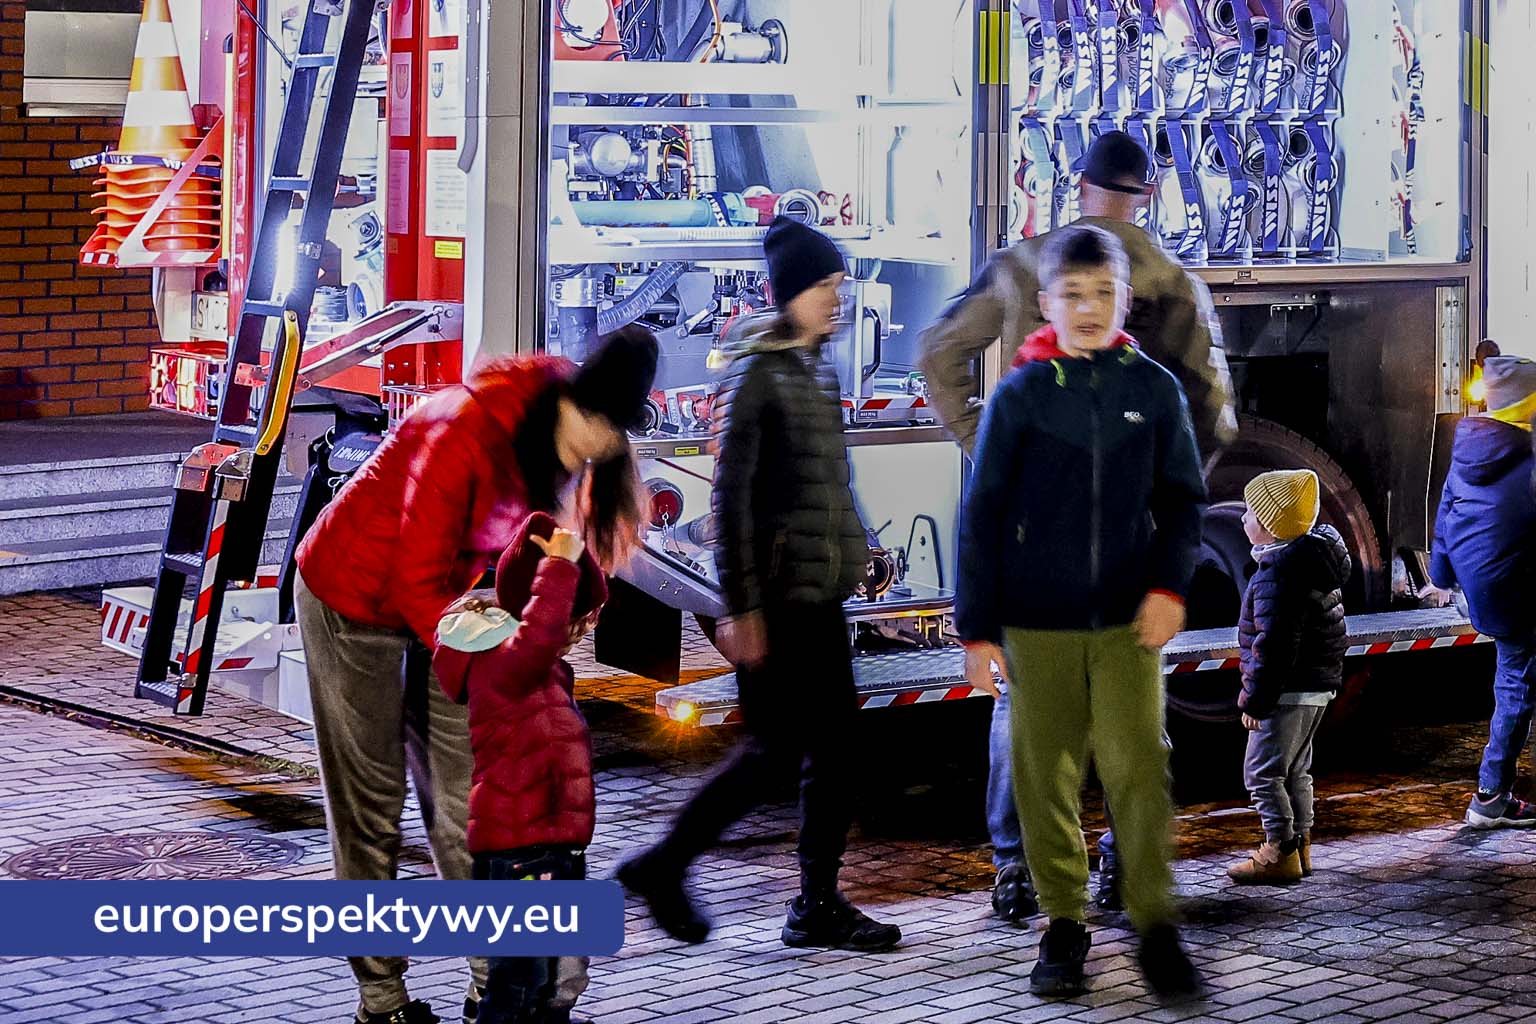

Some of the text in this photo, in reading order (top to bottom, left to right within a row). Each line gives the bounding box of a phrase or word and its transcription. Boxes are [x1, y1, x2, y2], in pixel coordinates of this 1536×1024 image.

[1074, 31, 1092, 96] WISS
[1101, 26, 1117, 95] WISS
[1139, 32, 1153, 97] WISS
[1188, 46, 1212, 108] WISS
[1228, 52, 1252, 112] WISS
[1263, 44, 1284, 111] WISS
[1311, 49, 1331, 111] WISS
[110, 155, 133, 165] WISS
[1177, 202, 1202, 255] WISS
[1222, 194, 1245, 254] WISS
[1264, 175, 1278, 239] WISS
[1311, 179, 1329, 241] WISS
